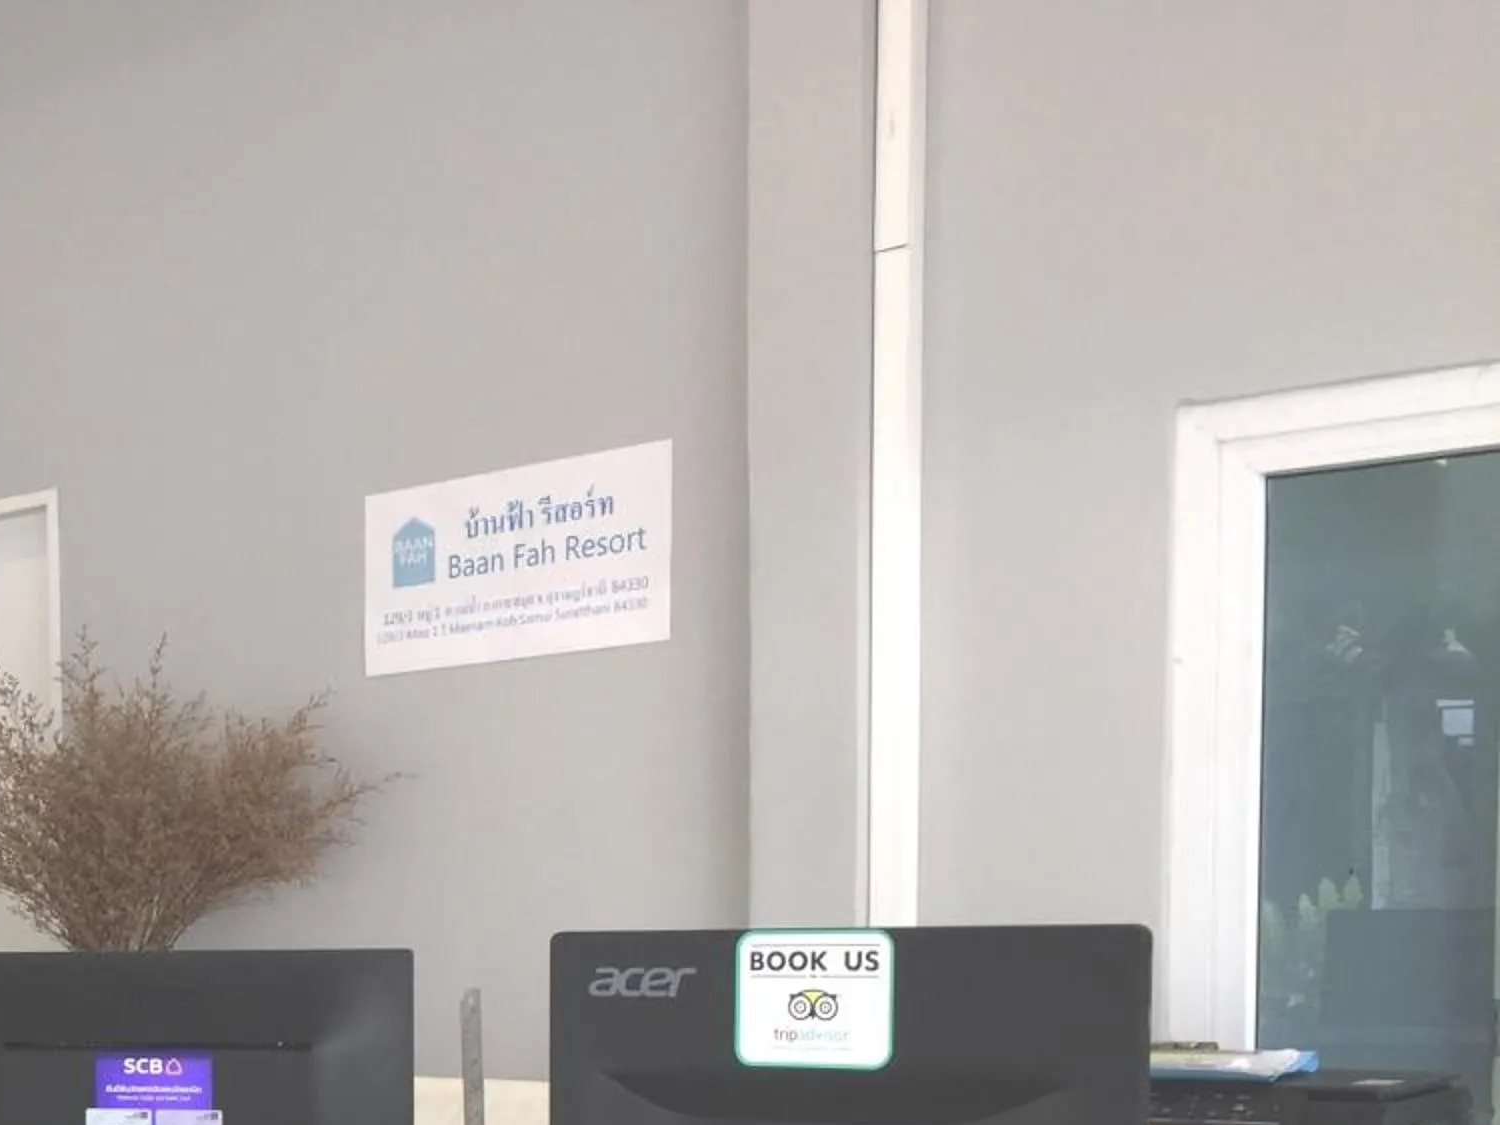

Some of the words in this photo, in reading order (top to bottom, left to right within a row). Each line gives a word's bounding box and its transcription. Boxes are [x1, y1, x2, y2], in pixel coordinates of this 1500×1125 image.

[465, 499, 534, 539] บ้านฟ้า
[448, 551, 505, 579] Baan
[513, 539, 556, 569] Fah
[565, 527, 647, 560] Resort
[749, 950, 828, 972] BOOK
[843, 950, 880, 972] US
[588, 966, 697, 998] acer
[773, 1026, 850, 1043] tripadvisor
[123, 1057, 163, 1075] SCB
